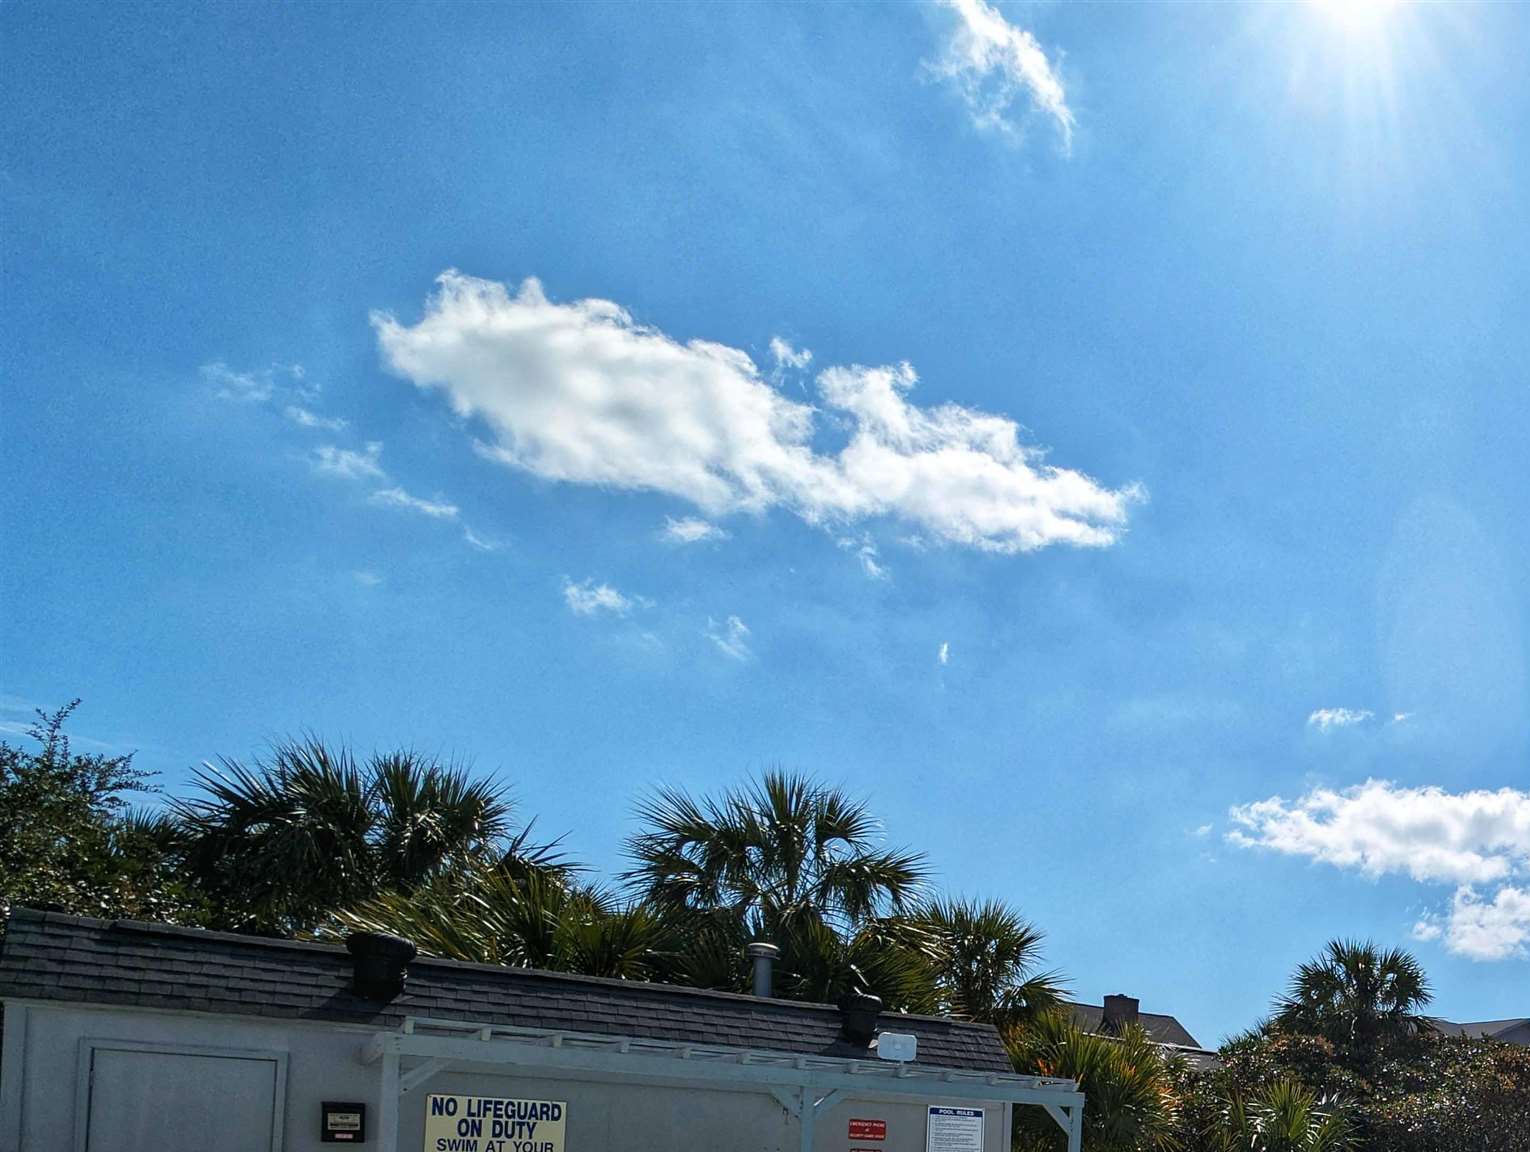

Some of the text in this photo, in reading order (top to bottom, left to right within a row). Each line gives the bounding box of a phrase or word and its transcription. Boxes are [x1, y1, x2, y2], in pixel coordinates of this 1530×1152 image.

[431, 1096, 562, 1121] NO LIFEGUARD
[457, 1118, 537, 1139] ON DUTY
[436, 1138, 478, 1152] SWIM
[485, 1140, 506, 1152] AT
